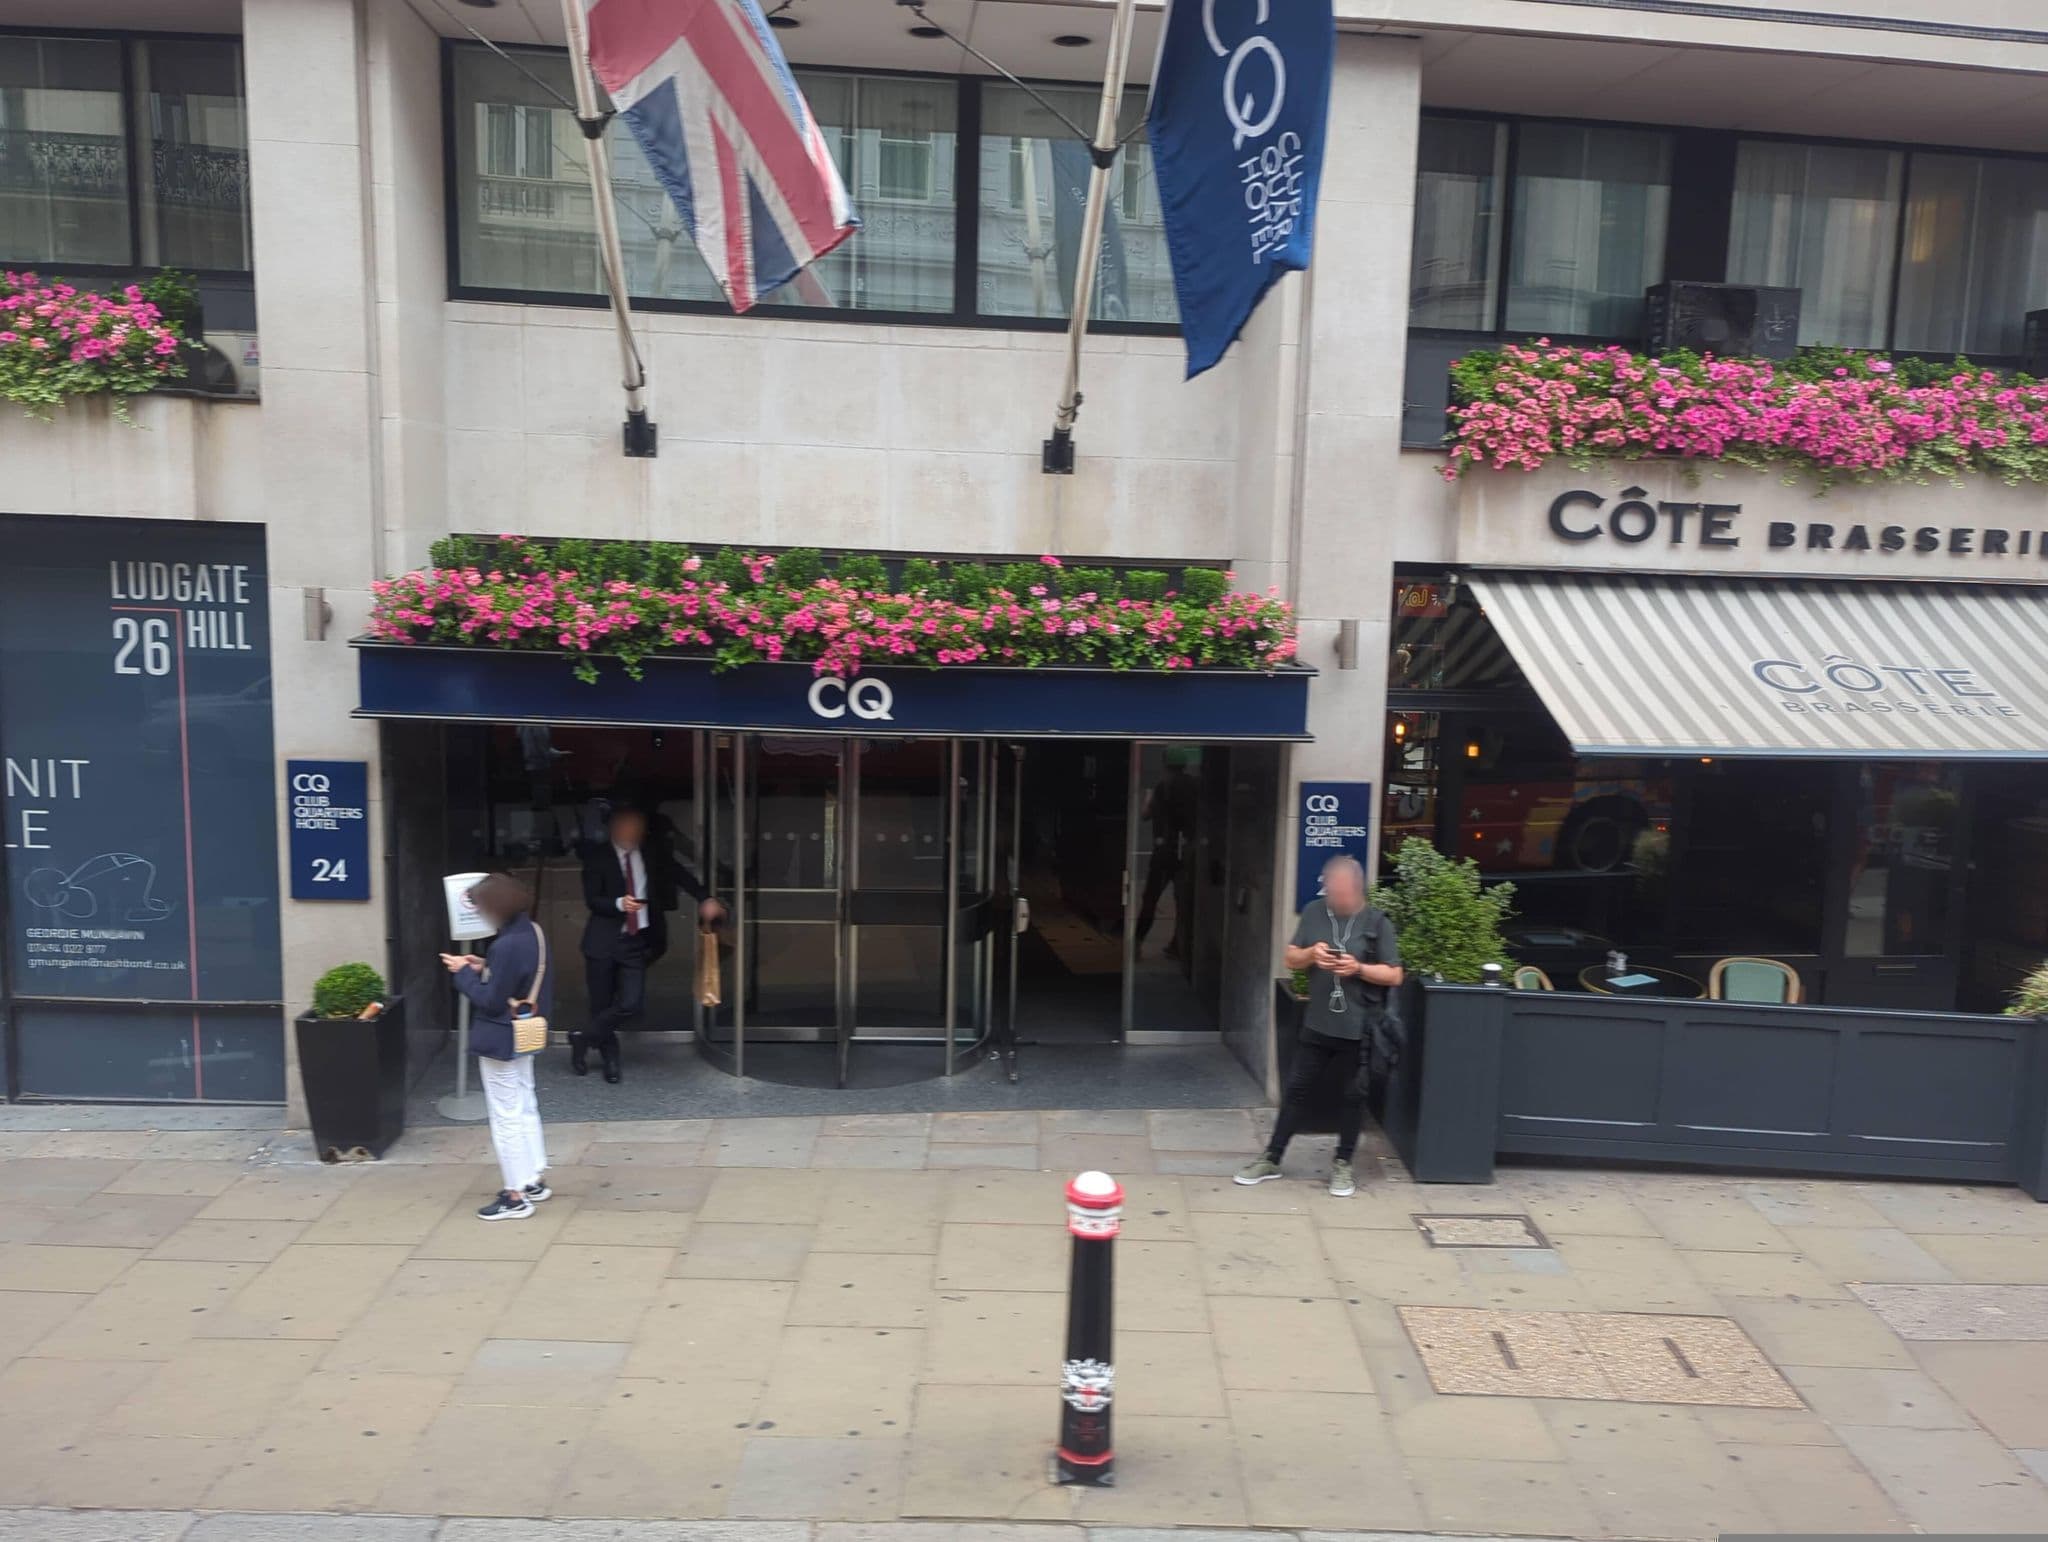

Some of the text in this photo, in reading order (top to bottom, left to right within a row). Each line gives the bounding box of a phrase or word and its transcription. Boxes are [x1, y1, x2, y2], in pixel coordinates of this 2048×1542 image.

[1549, 485, 2048, 558] CÔTE BRASSERI
[110, 560, 250, 604] LUDGATE
[187, 609, 252, 650] HILL
[113, 617, 171, 676] 26
[1752, 654, 1998, 697] CÔTE
[808, 676, 894, 720] CQ
[1782, 701, 2021, 718] BRASSERIE
[293, 773, 330, 792] CQ
[294, 795, 330, 807] CLUB
[1306, 794, 1339, 812] CQ
[294, 806, 363, 819] QUARTERS
[1306, 815, 1337, 826] CLUB
[296, 818, 340, 829] HOTEL
[1305, 825, 1366, 837] QUARTERS
[1305, 836, 1344, 848] HOTEL
[312, 858, 348, 881] 24
